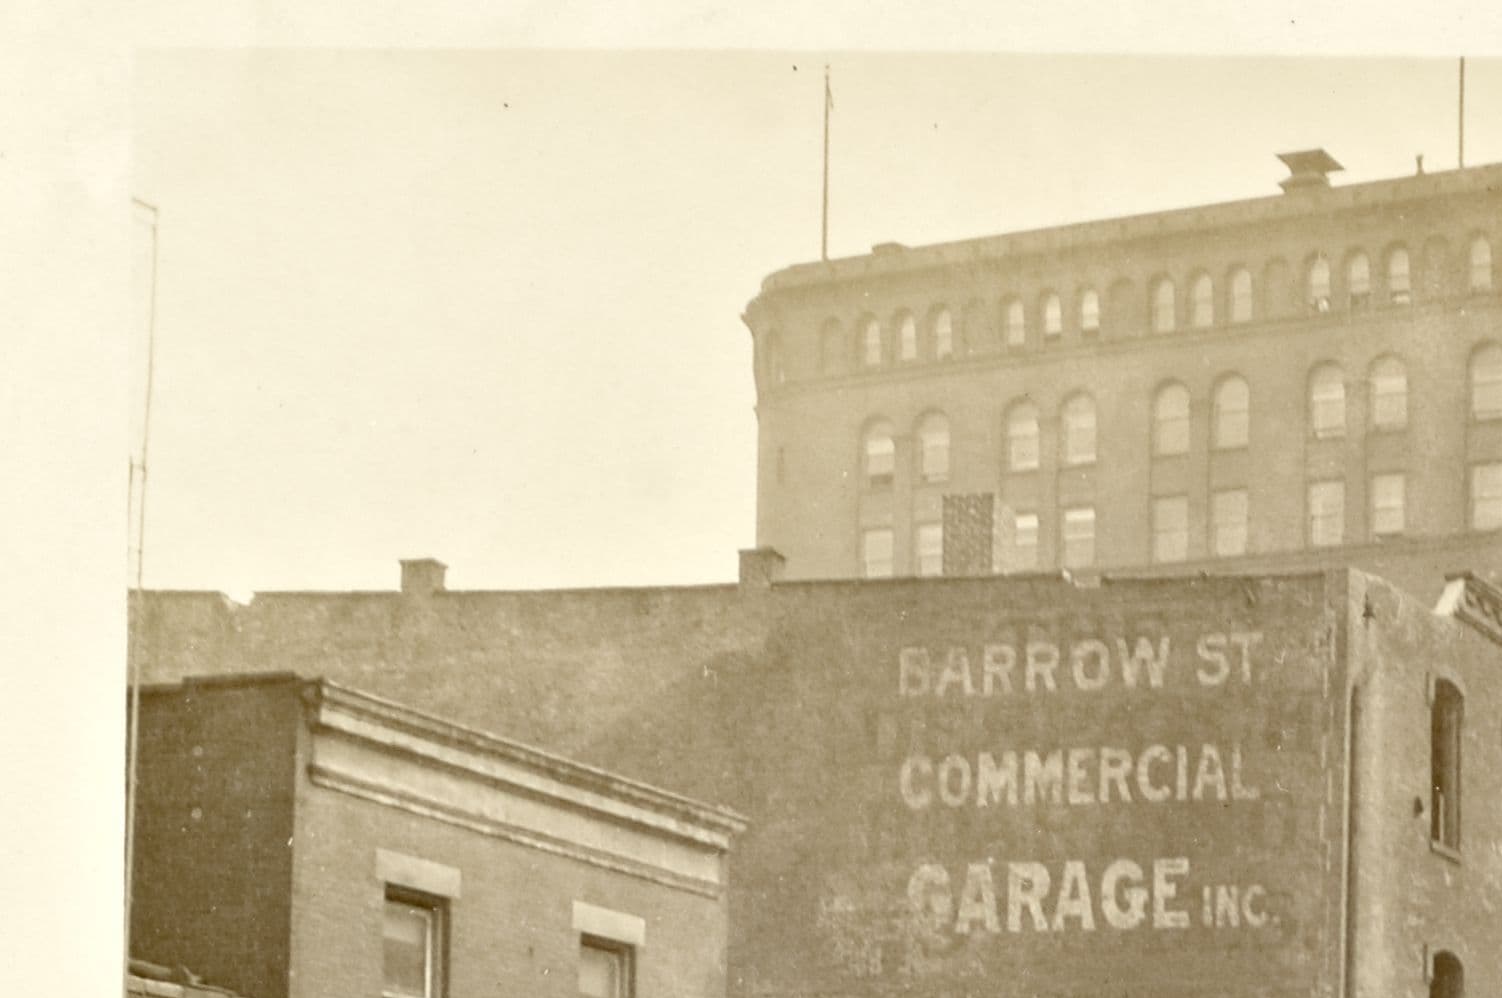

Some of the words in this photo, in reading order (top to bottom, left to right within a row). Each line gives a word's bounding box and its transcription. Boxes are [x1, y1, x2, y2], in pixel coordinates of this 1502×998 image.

[901, 637, 1170, 697] BARROW
[1197, 631, 1263, 686] ST
[901, 744, 1259, 808] COMMERCIAL
[907, 857, 1190, 934] GARAGE
[1203, 884, 1281, 929] INC.
